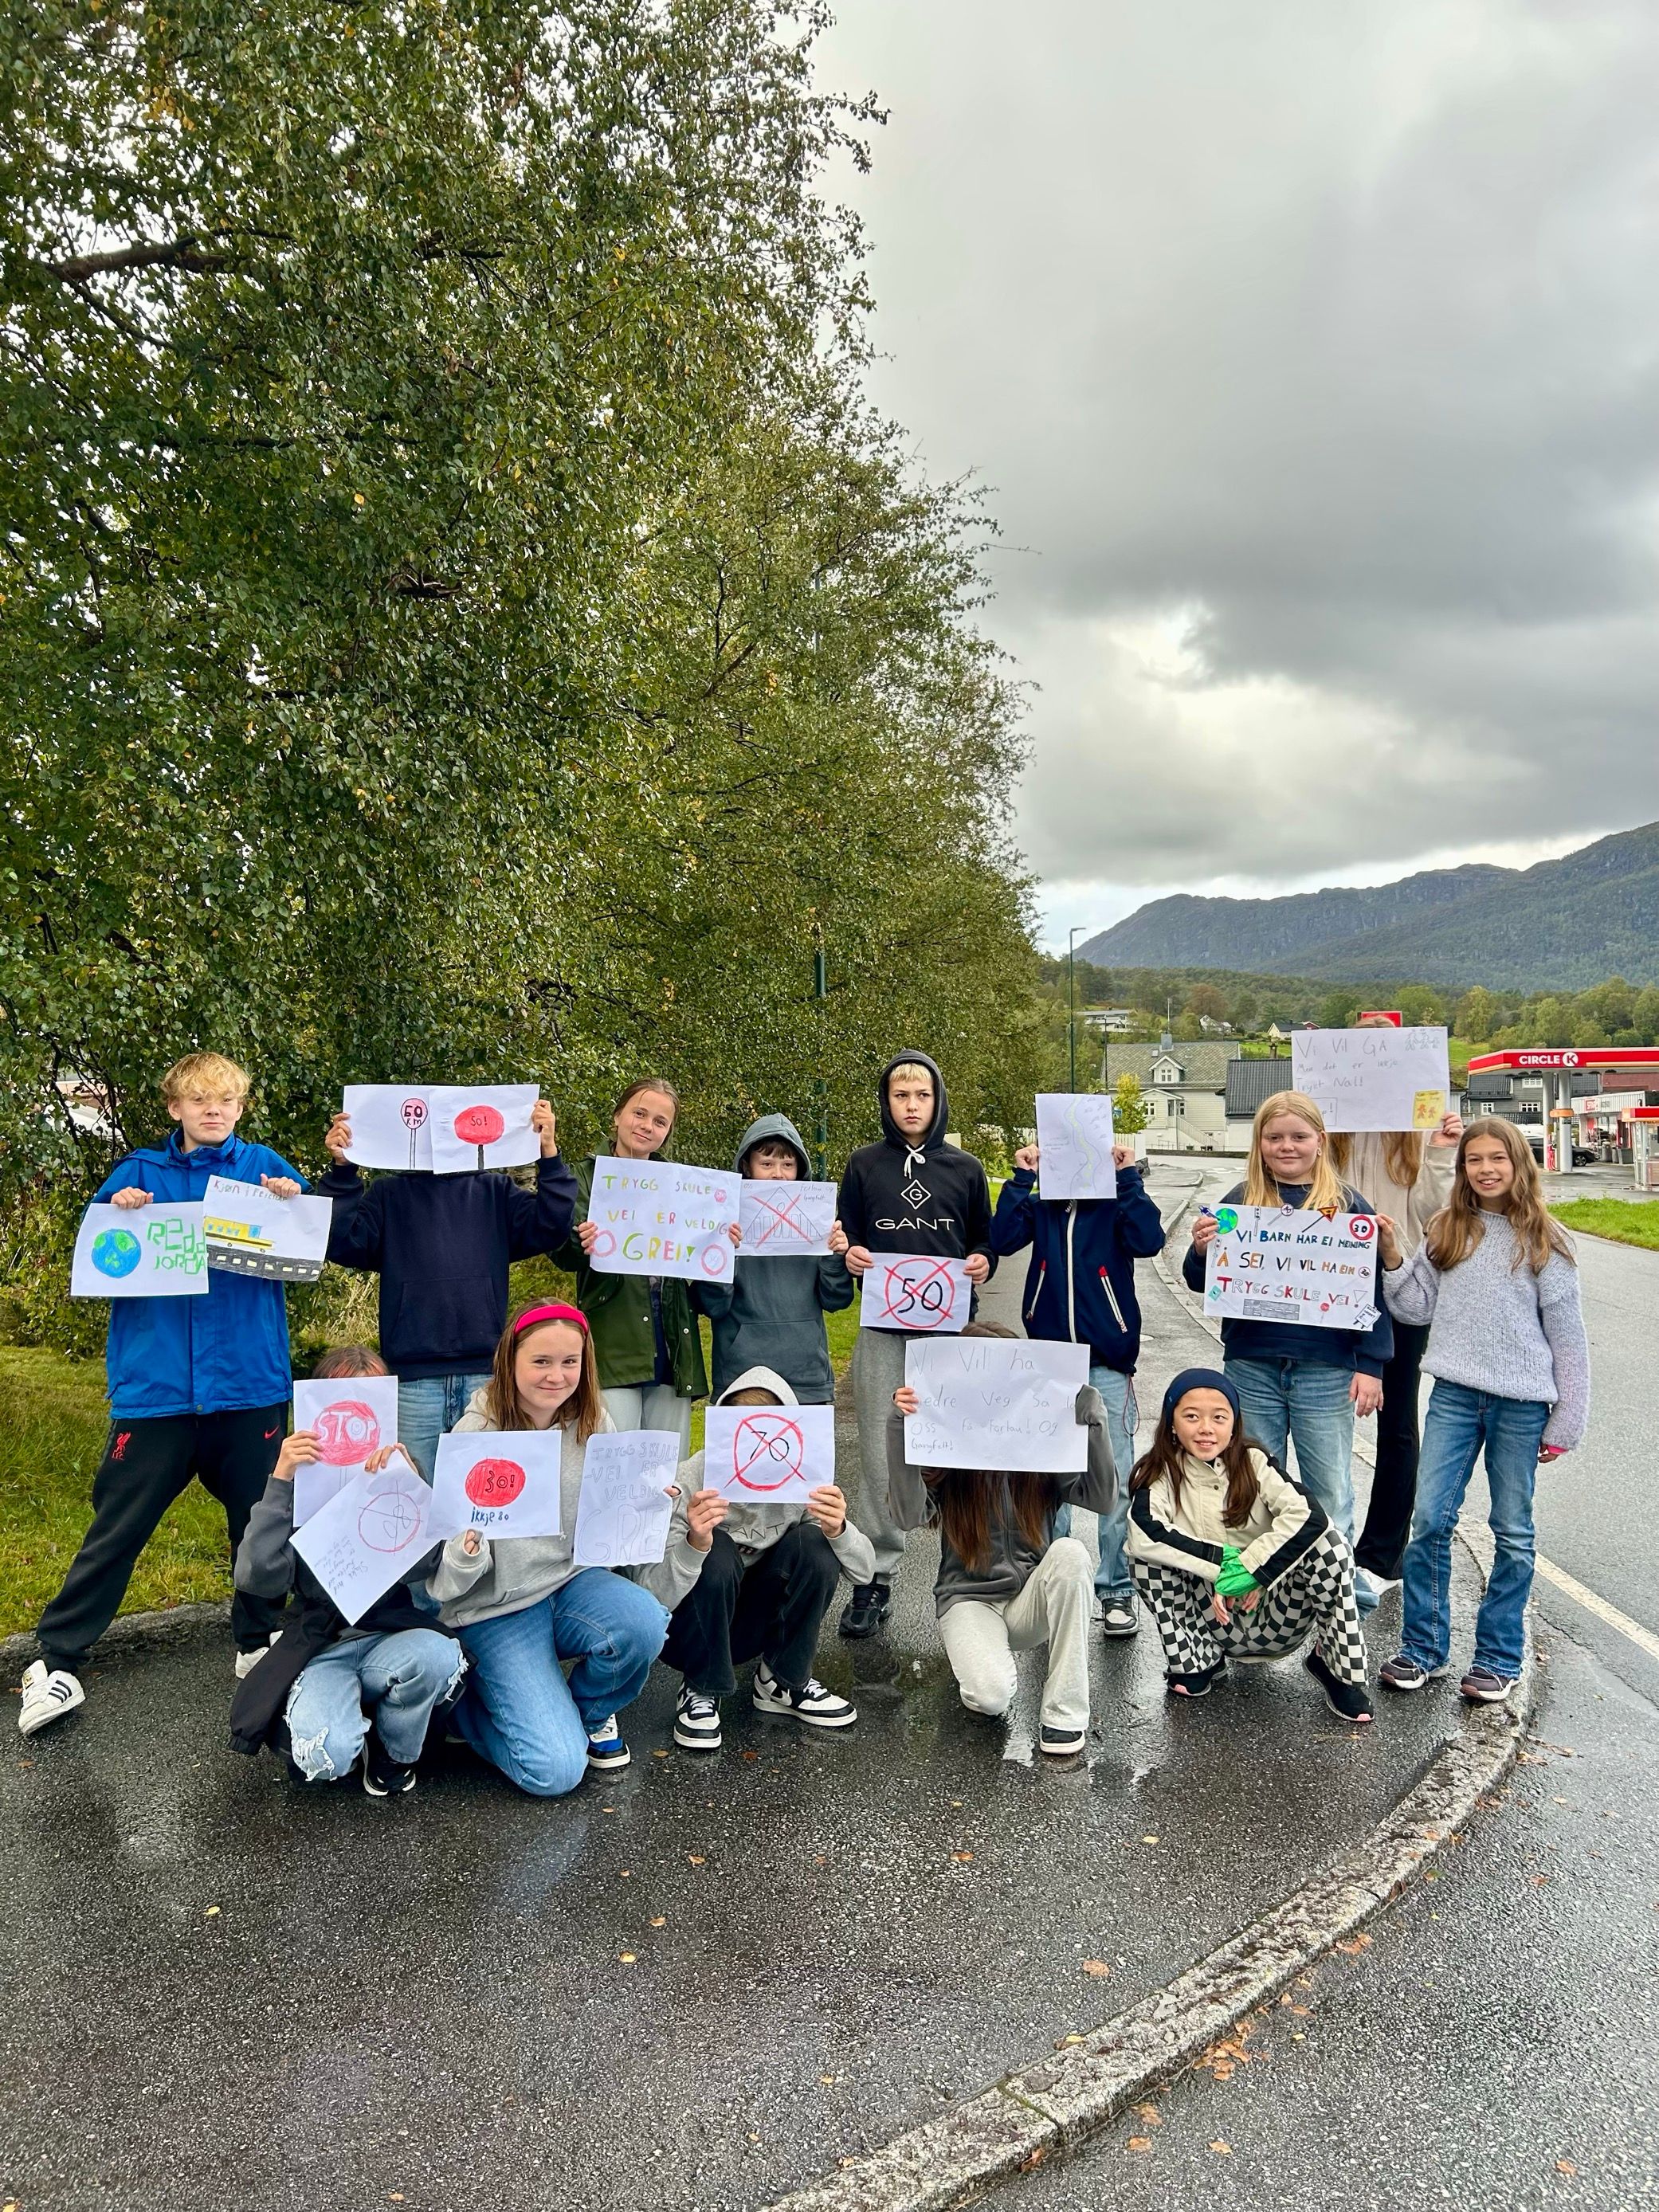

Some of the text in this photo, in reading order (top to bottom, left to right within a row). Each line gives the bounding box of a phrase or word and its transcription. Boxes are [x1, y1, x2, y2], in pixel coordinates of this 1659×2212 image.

[1519, 1053, 1578, 1066] CIRCLE K
[602, 1175, 658, 1191] TRYGG
[676, 1181, 712, 1195] SKULE
[909, 1188, 923, 1201] G
[607, 1210, 728, 1235] VEI ER VELDIG
[875, 1217, 955, 1230] GANT
[1354, 1223, 1367, 1233] 30
[622, 1233, 696, 1263] GREI!
[1236, 1230, 1371, 1249] VI BARN HAR EI MEINING
[1217, 1246, 1229, 1267] Å
[1277, 1257, 1292, 1272] VI
[1300, 1259, 1316, 1272] VIL
[1321, 1261, 1337, 1273] HA
[1339, 1264, 1355, 1275] EIN
[897, 1277, 943, 1314] 50
[1217, 1277, 1270, 1295] TRYGG
[1274, 1284, 1320, 1302] SKULE
[910, 1343, 1035, 1375] Vi Vil ha
[319, 1410, 377, 1443] STOP
[751, 1431, 789, 1461] 70
[485, 1470, 516, 1493] 30!
